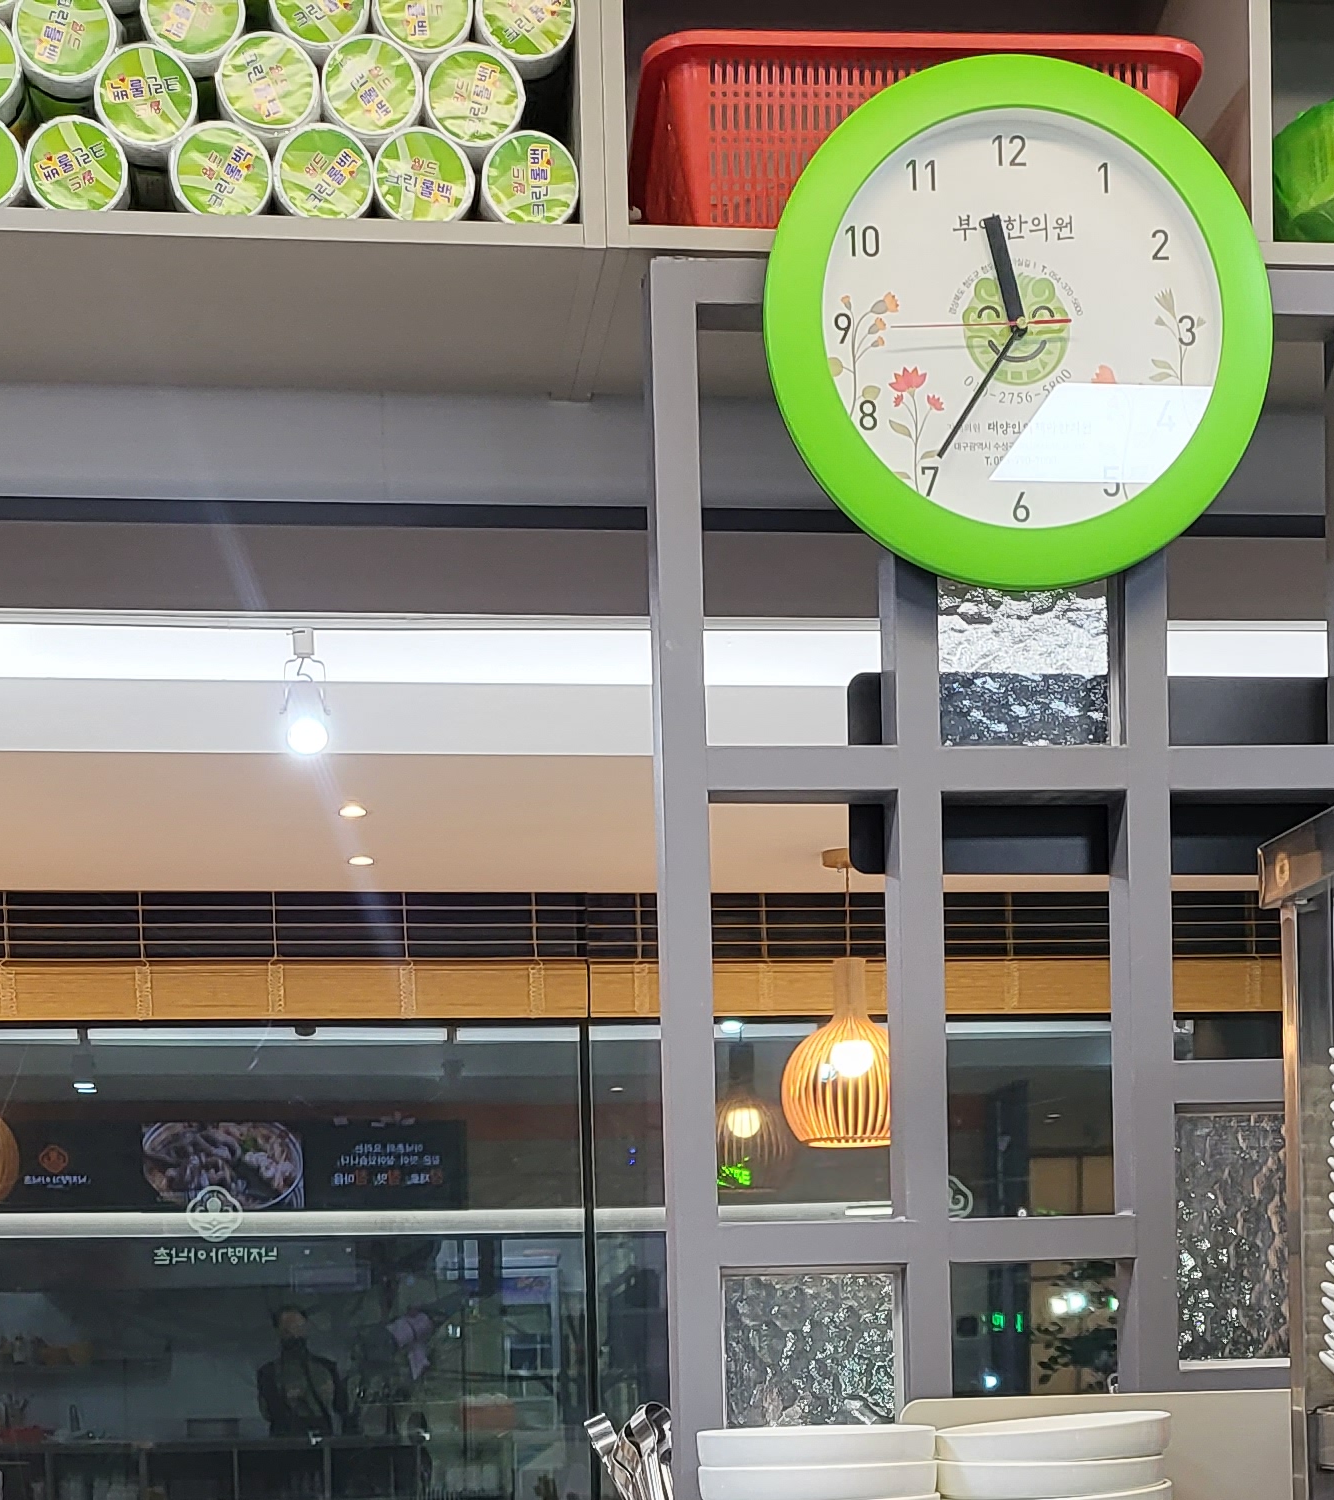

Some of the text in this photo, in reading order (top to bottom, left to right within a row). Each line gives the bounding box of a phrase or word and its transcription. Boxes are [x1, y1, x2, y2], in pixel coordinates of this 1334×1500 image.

[991, 134, 1027, 168] 12
[905, 159, 937, 192] 11
[1097, 162, 1110, 194] 1
[845, 225, 880, 258] 10
[1151, 229, 1169, 262] 2
[833, 313, 852, 346] 9
[1178, 315, 1197, 347] 3
[859, 399, 878, 431] 8
[921, 465, 939, 497] 7
[1012, 492, 1030, 523] 6
